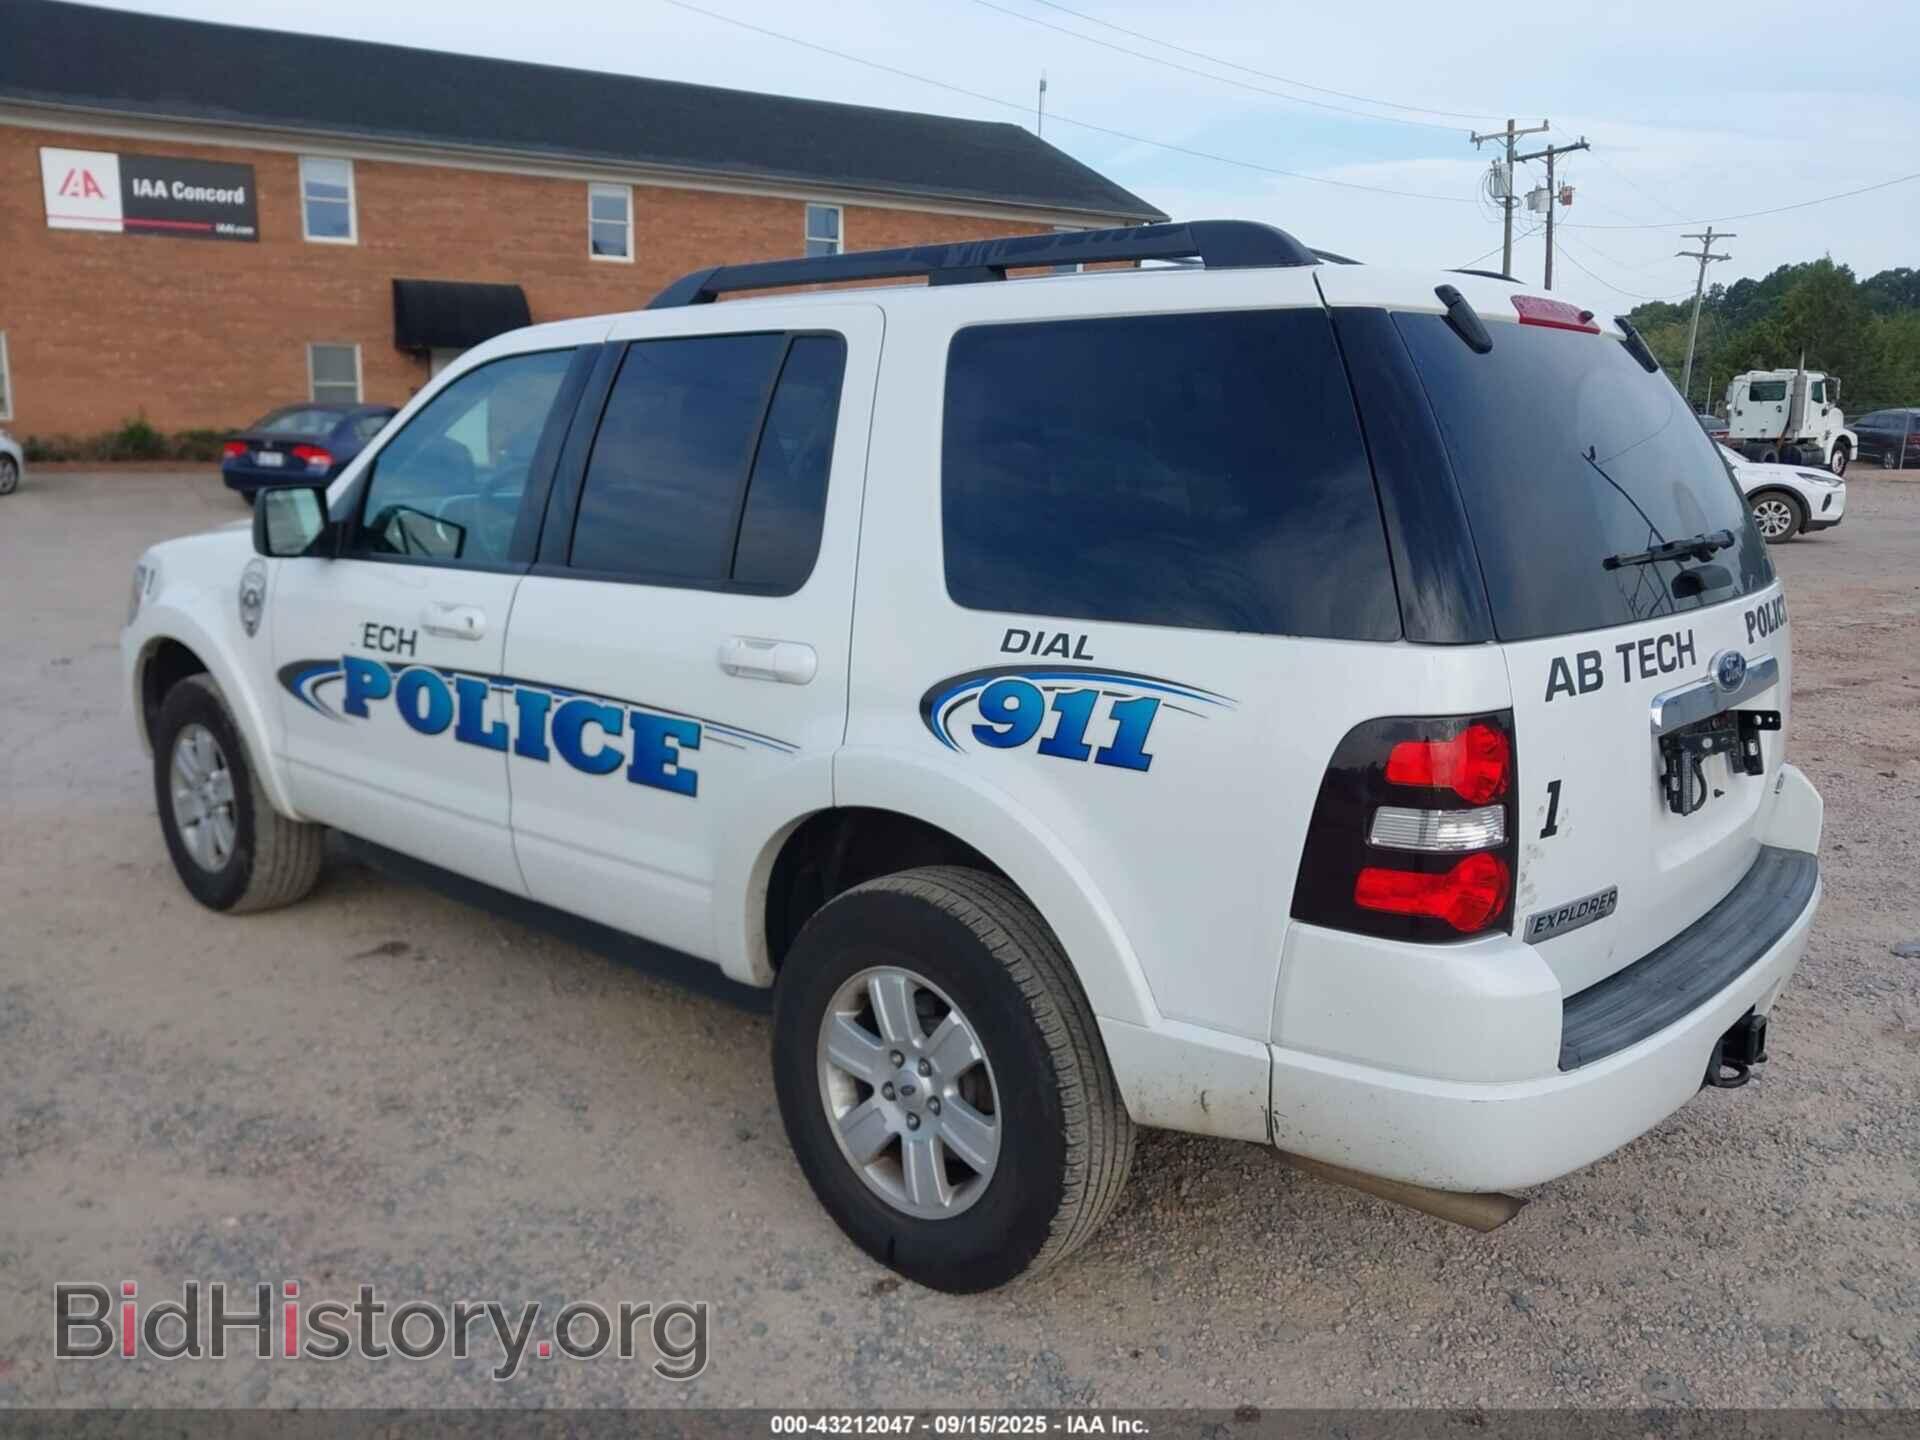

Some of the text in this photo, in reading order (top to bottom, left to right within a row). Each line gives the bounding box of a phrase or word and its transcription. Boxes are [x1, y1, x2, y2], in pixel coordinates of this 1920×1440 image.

[132, 178, 245, 204] IAA Concord
[362, 622, 418, 657] ECH
[1000, 628, 1095, 661] DIAL
[1544, 593, 1788, 702] AB TECH POLIC
[341, 654, 702, 798] POLICE
[970, 677, 1162, 773] 911
[1539, 779, 1562, 839] 1
[1533, 890, 1618, 934] EXPLORER
